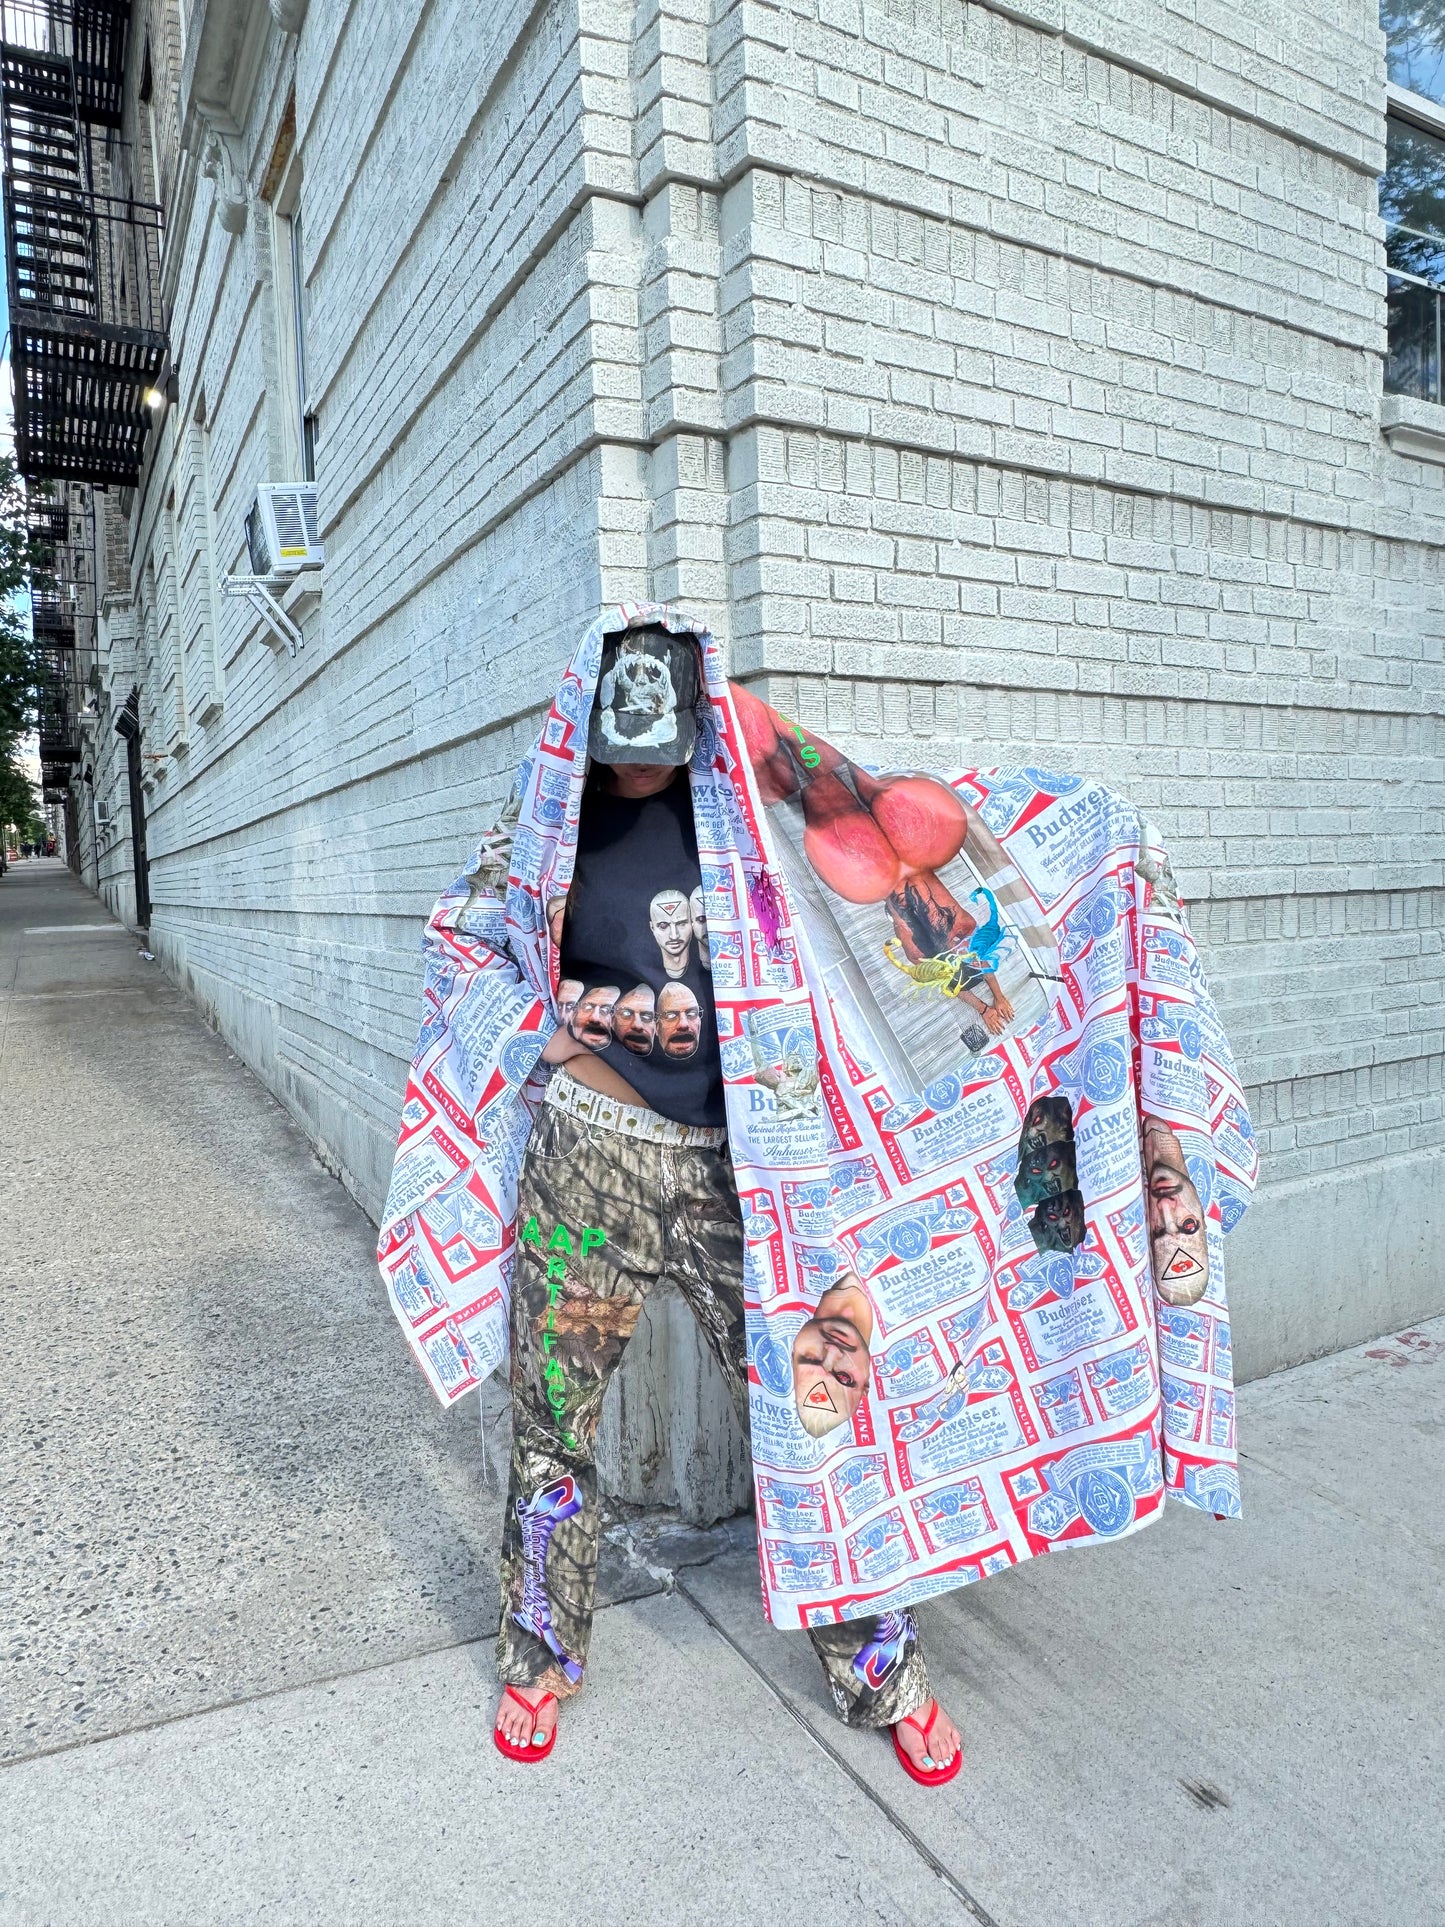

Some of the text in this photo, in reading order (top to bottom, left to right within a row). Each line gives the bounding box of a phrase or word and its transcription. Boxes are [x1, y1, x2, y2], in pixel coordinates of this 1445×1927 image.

[426, 1076, 468, 1128] GENUINE
[821, 1073, 856, 1147] GENUINE
[434, 1129, 466, 1167] GENUINE
[763, 1135, 791, 1144] LARGEST
[1108, 1275, 1135, 1328] GENUINE
[1012, 1319, 1035, 1370] GENUINE
[1013, 1390, 1037, 1442] GENUINE
